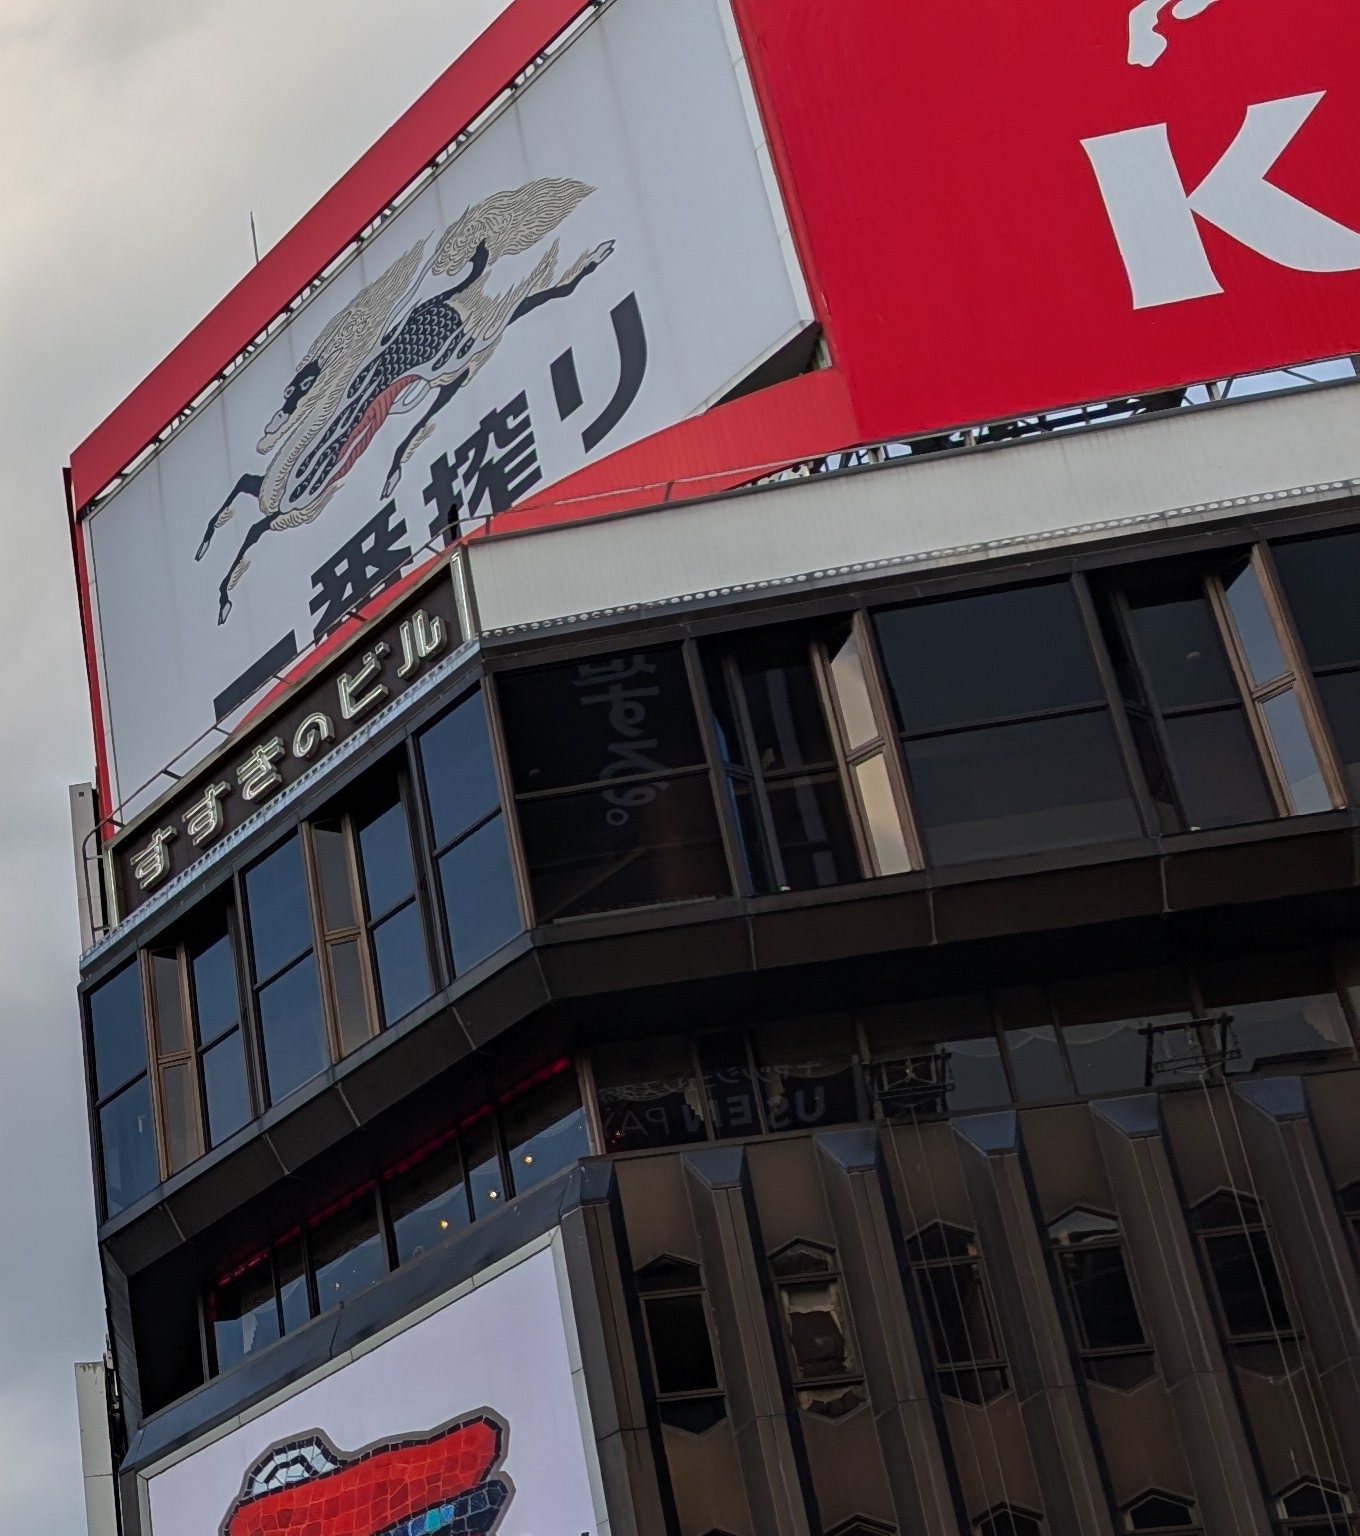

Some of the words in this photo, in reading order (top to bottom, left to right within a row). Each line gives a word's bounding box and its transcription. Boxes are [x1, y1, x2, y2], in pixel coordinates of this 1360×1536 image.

[213, 291, 648, 726] 一番搾り
[129, 606, 445, 890] すすきのビル
